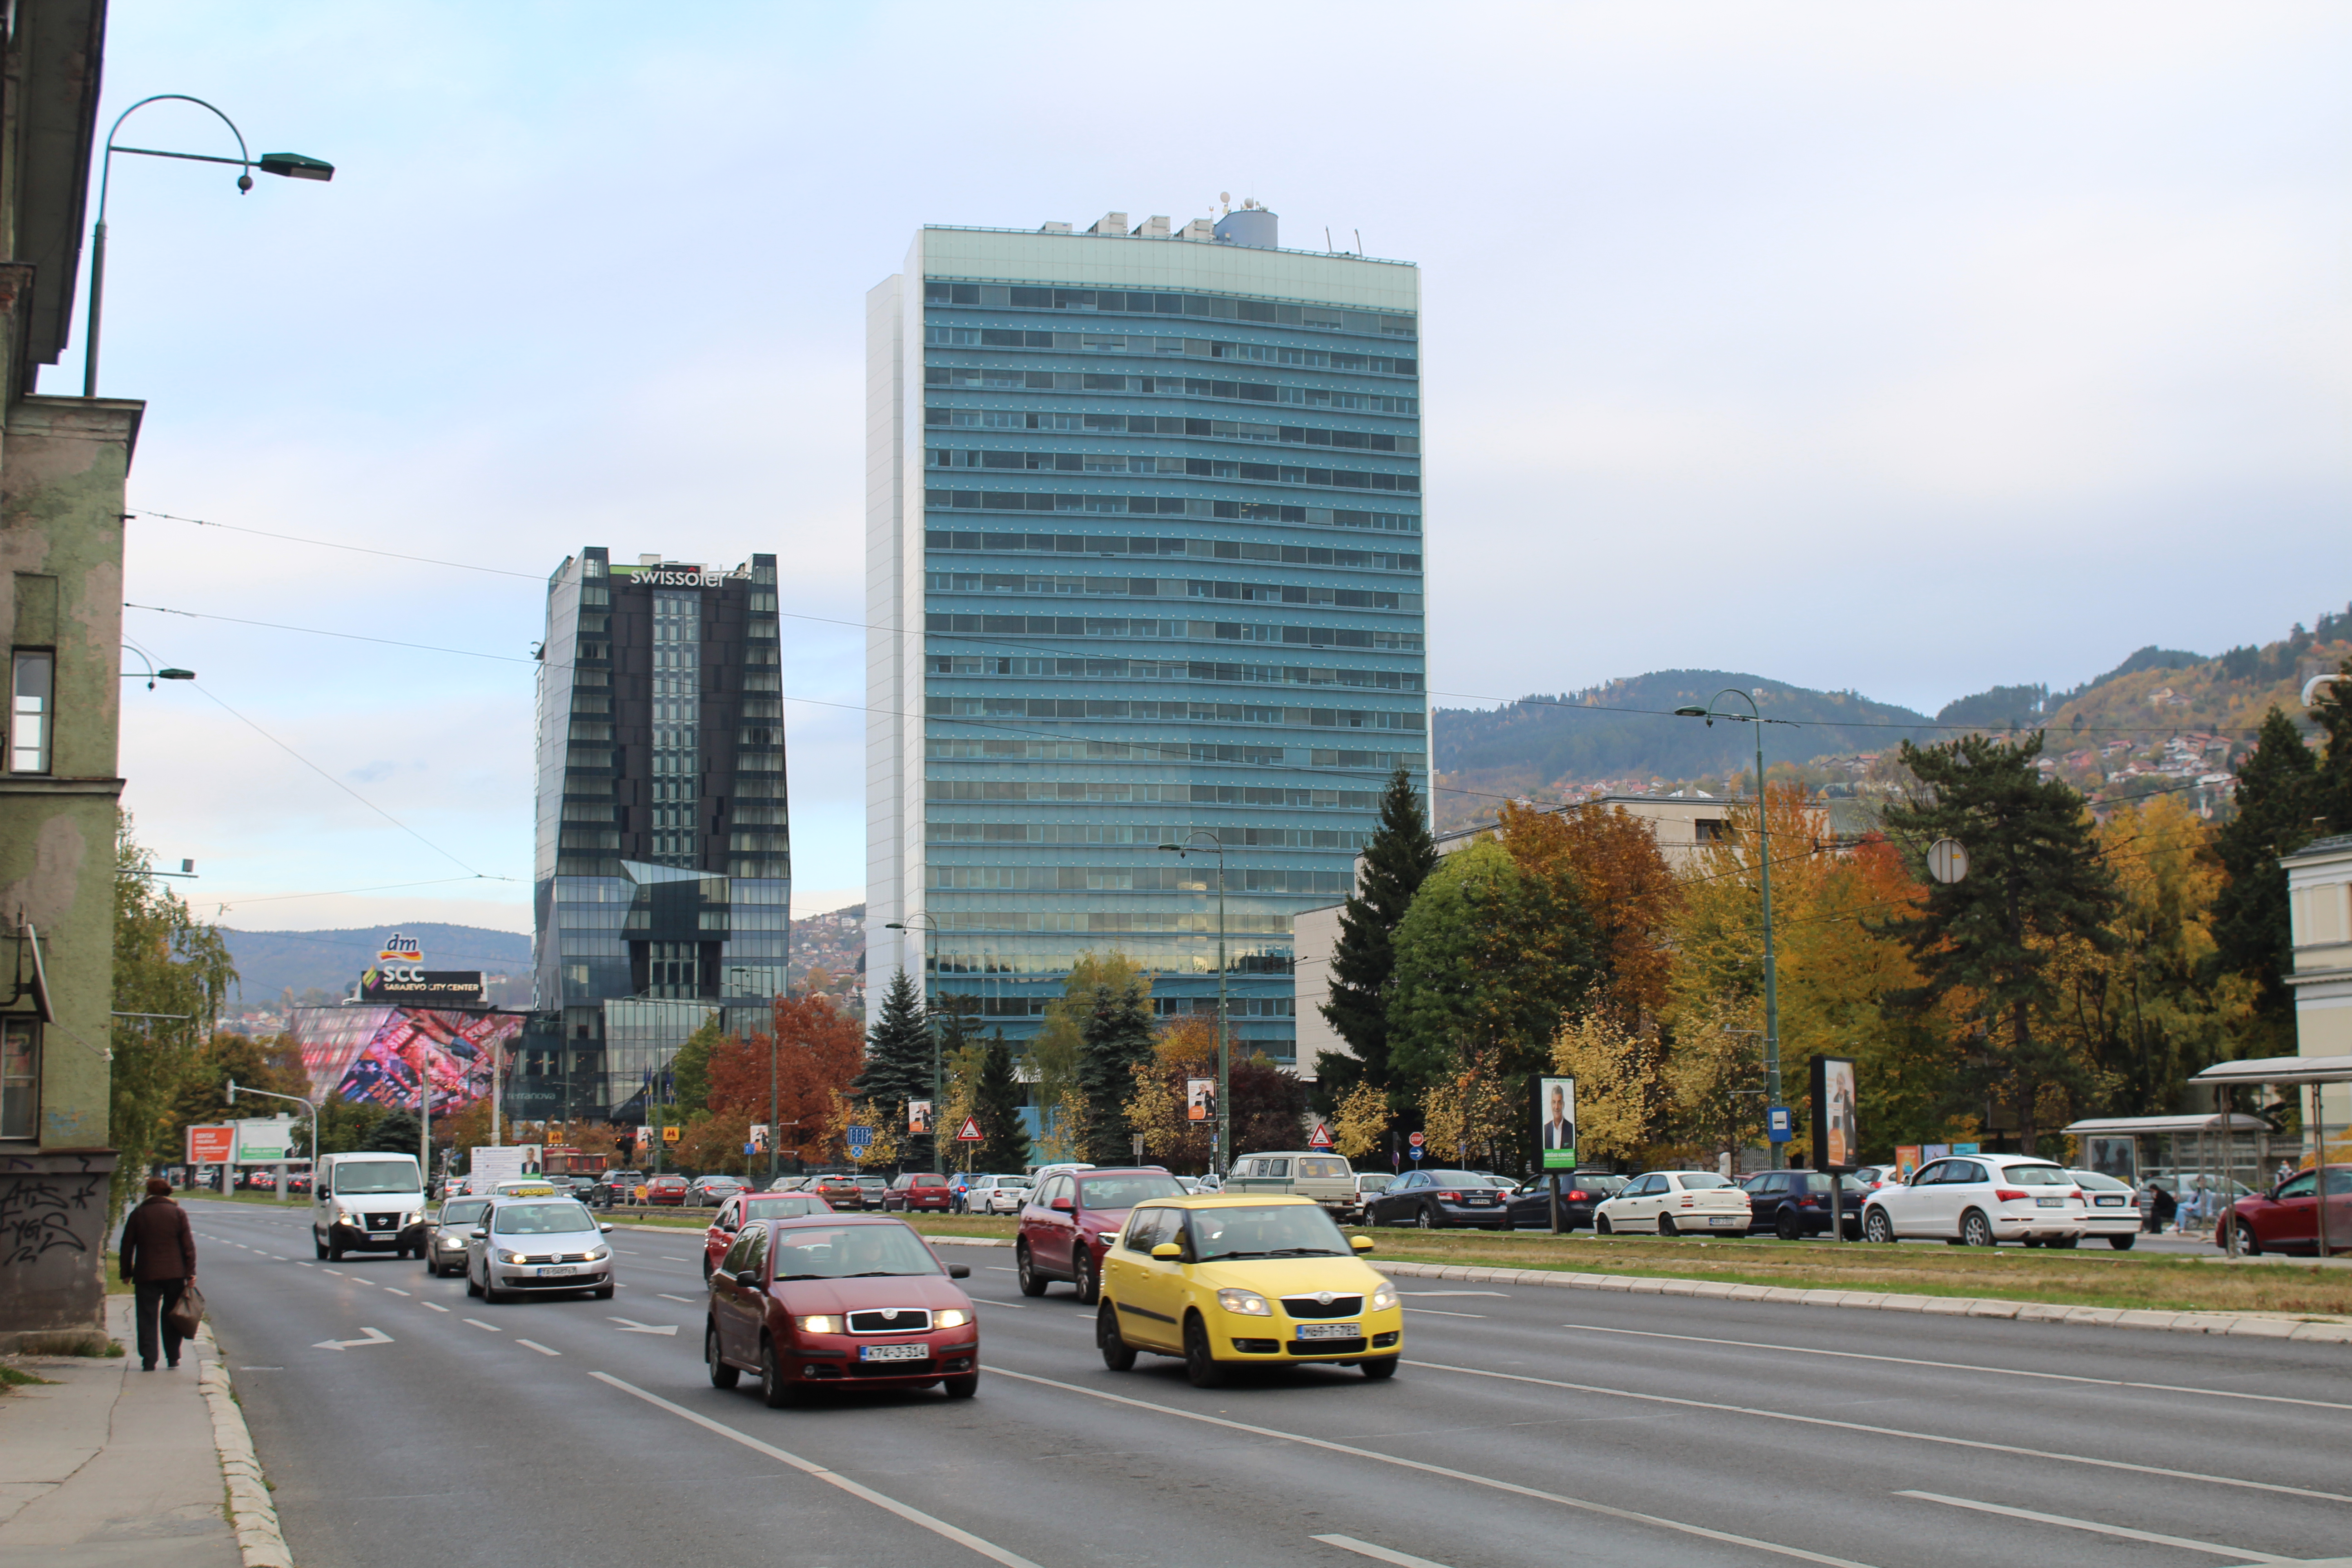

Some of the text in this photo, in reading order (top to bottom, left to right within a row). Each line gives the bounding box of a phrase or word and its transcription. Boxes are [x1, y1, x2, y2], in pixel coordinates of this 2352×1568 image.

[387, 934, 418, 951] dm
[383, 965, 425, 982] SCC
[446, 983, 479, 991] CENTER
[868, 1345, 927, 1359] K74-J-314
